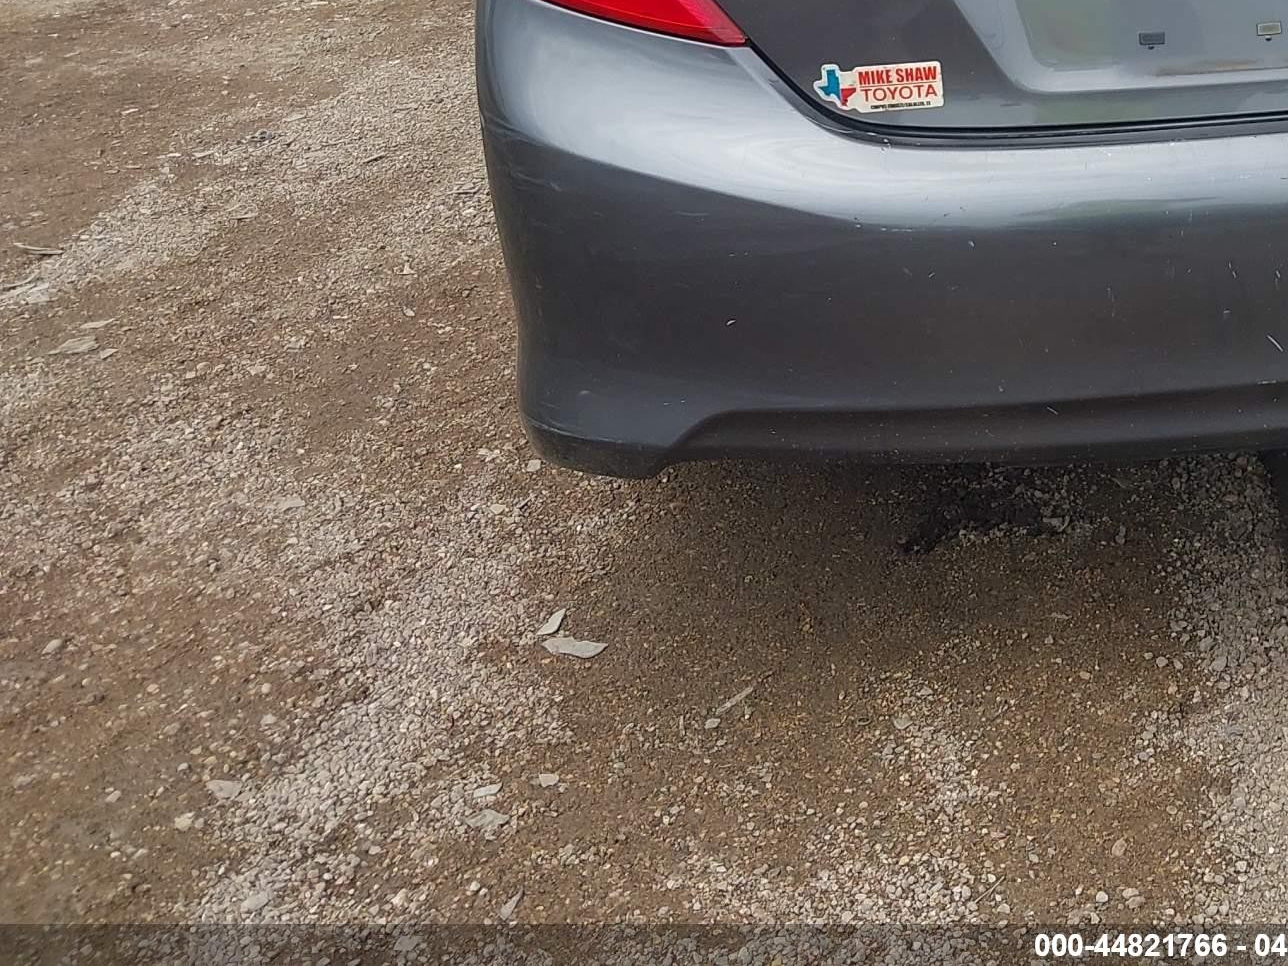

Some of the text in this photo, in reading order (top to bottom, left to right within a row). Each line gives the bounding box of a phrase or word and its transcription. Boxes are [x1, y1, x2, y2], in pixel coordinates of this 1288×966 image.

[858, 66, 938, 85] MIKE SHAW
[860, 83, 938, 102] TOYOTA
